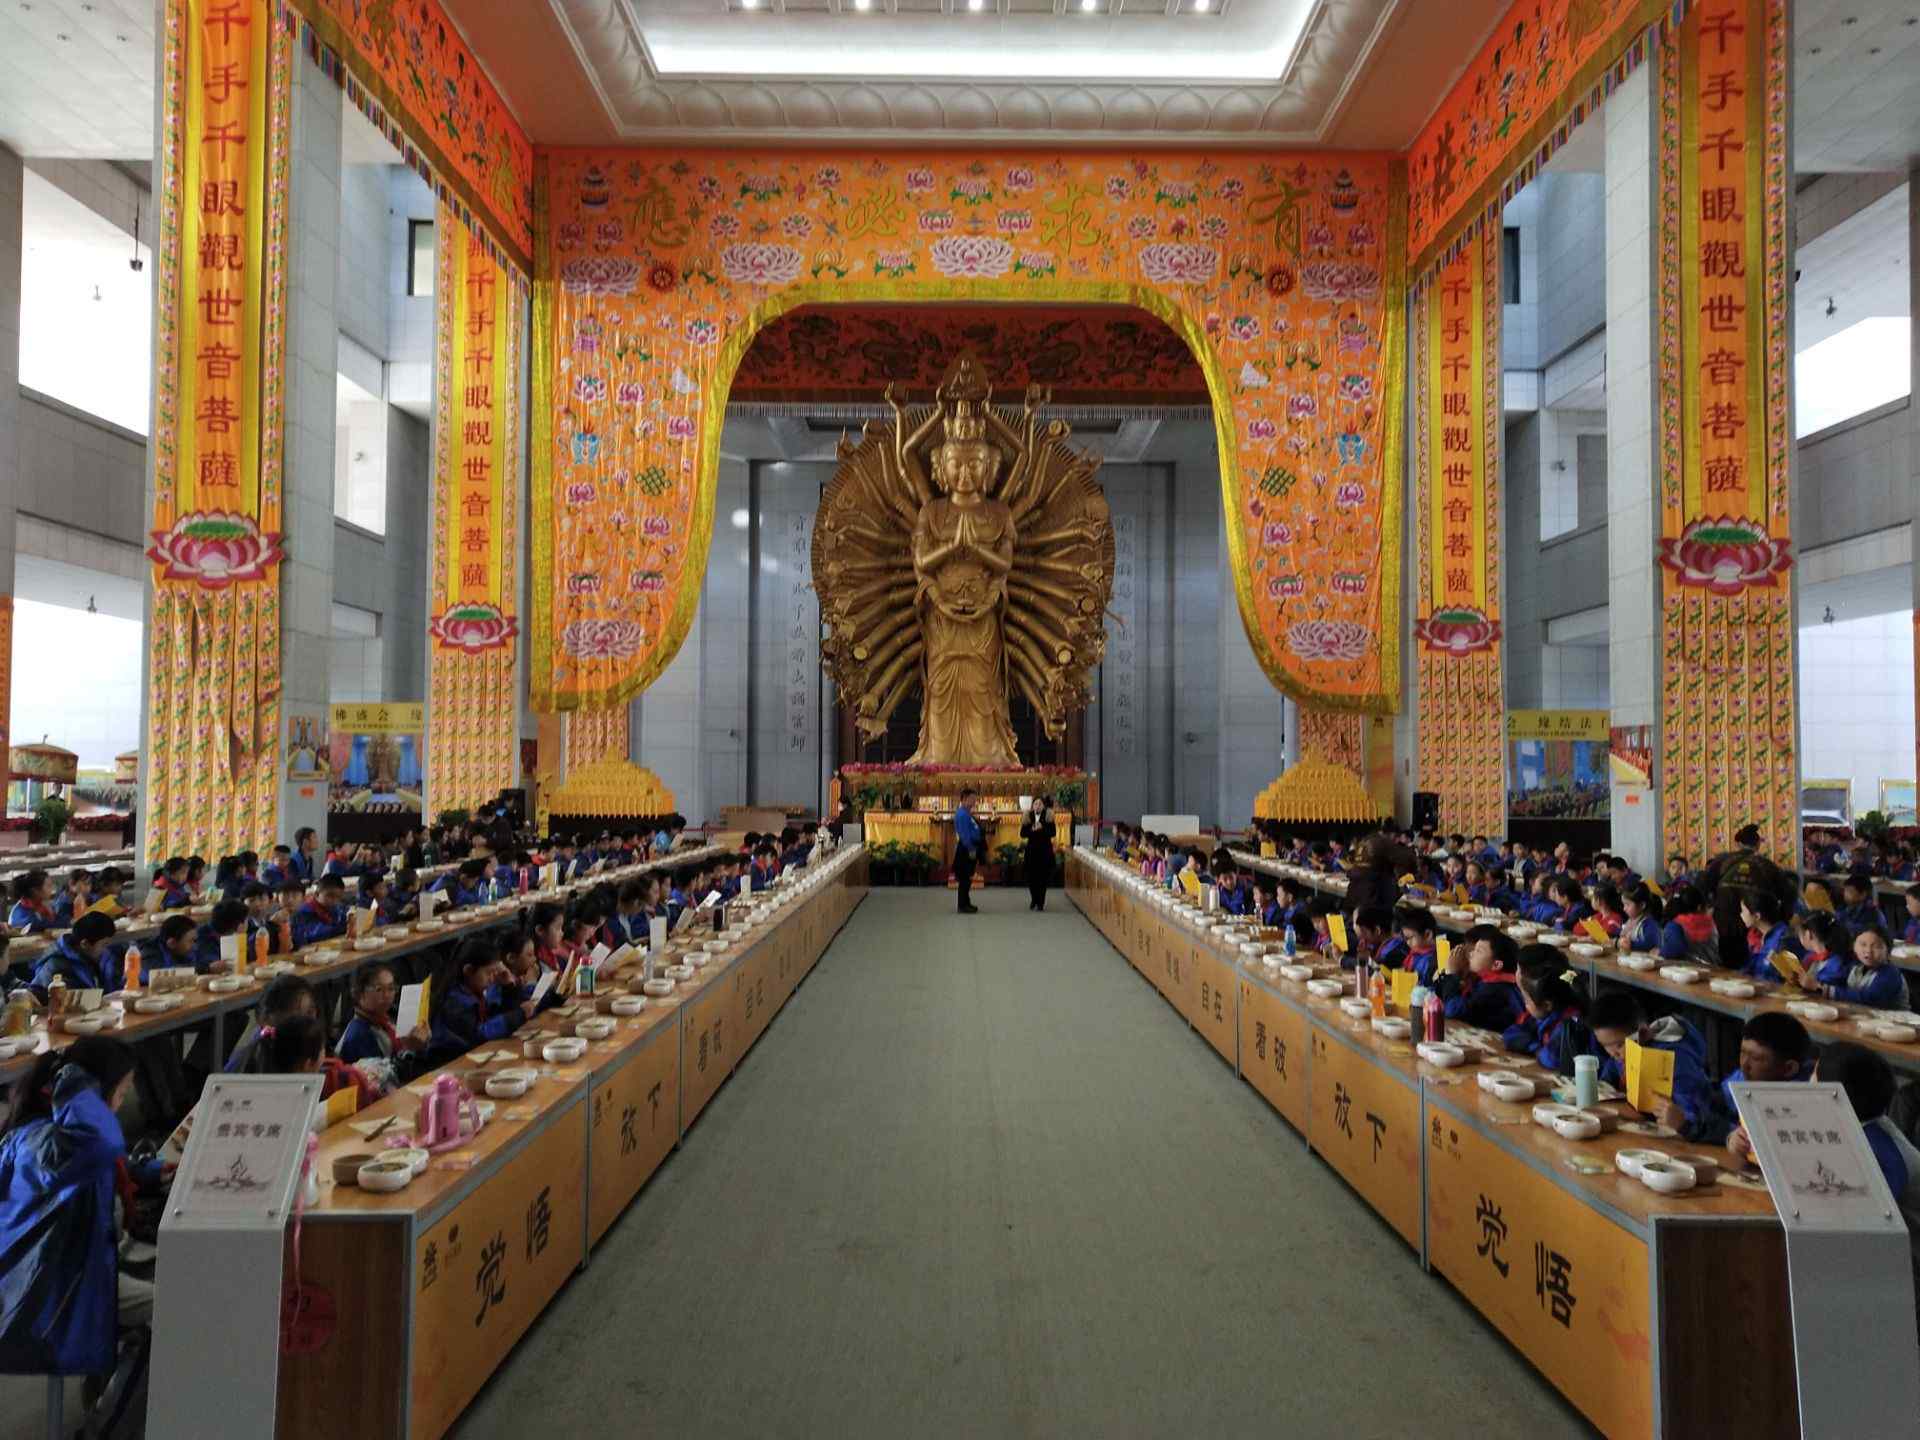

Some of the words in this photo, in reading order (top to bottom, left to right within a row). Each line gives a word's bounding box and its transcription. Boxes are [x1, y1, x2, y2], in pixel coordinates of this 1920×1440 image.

[197, 3, 250, 488] 千手千眼觀世音菩薩
[1698, 9, 1746, 494] 千手千眼觀世音菩薩
[620, 1081, 662, 1157] 放下
[1334, 1081, 1387, 1163] 放下
[474, 1185, 552, 1329] 觉悟
[1476, 1193, 1577, 1329] 觉悟
